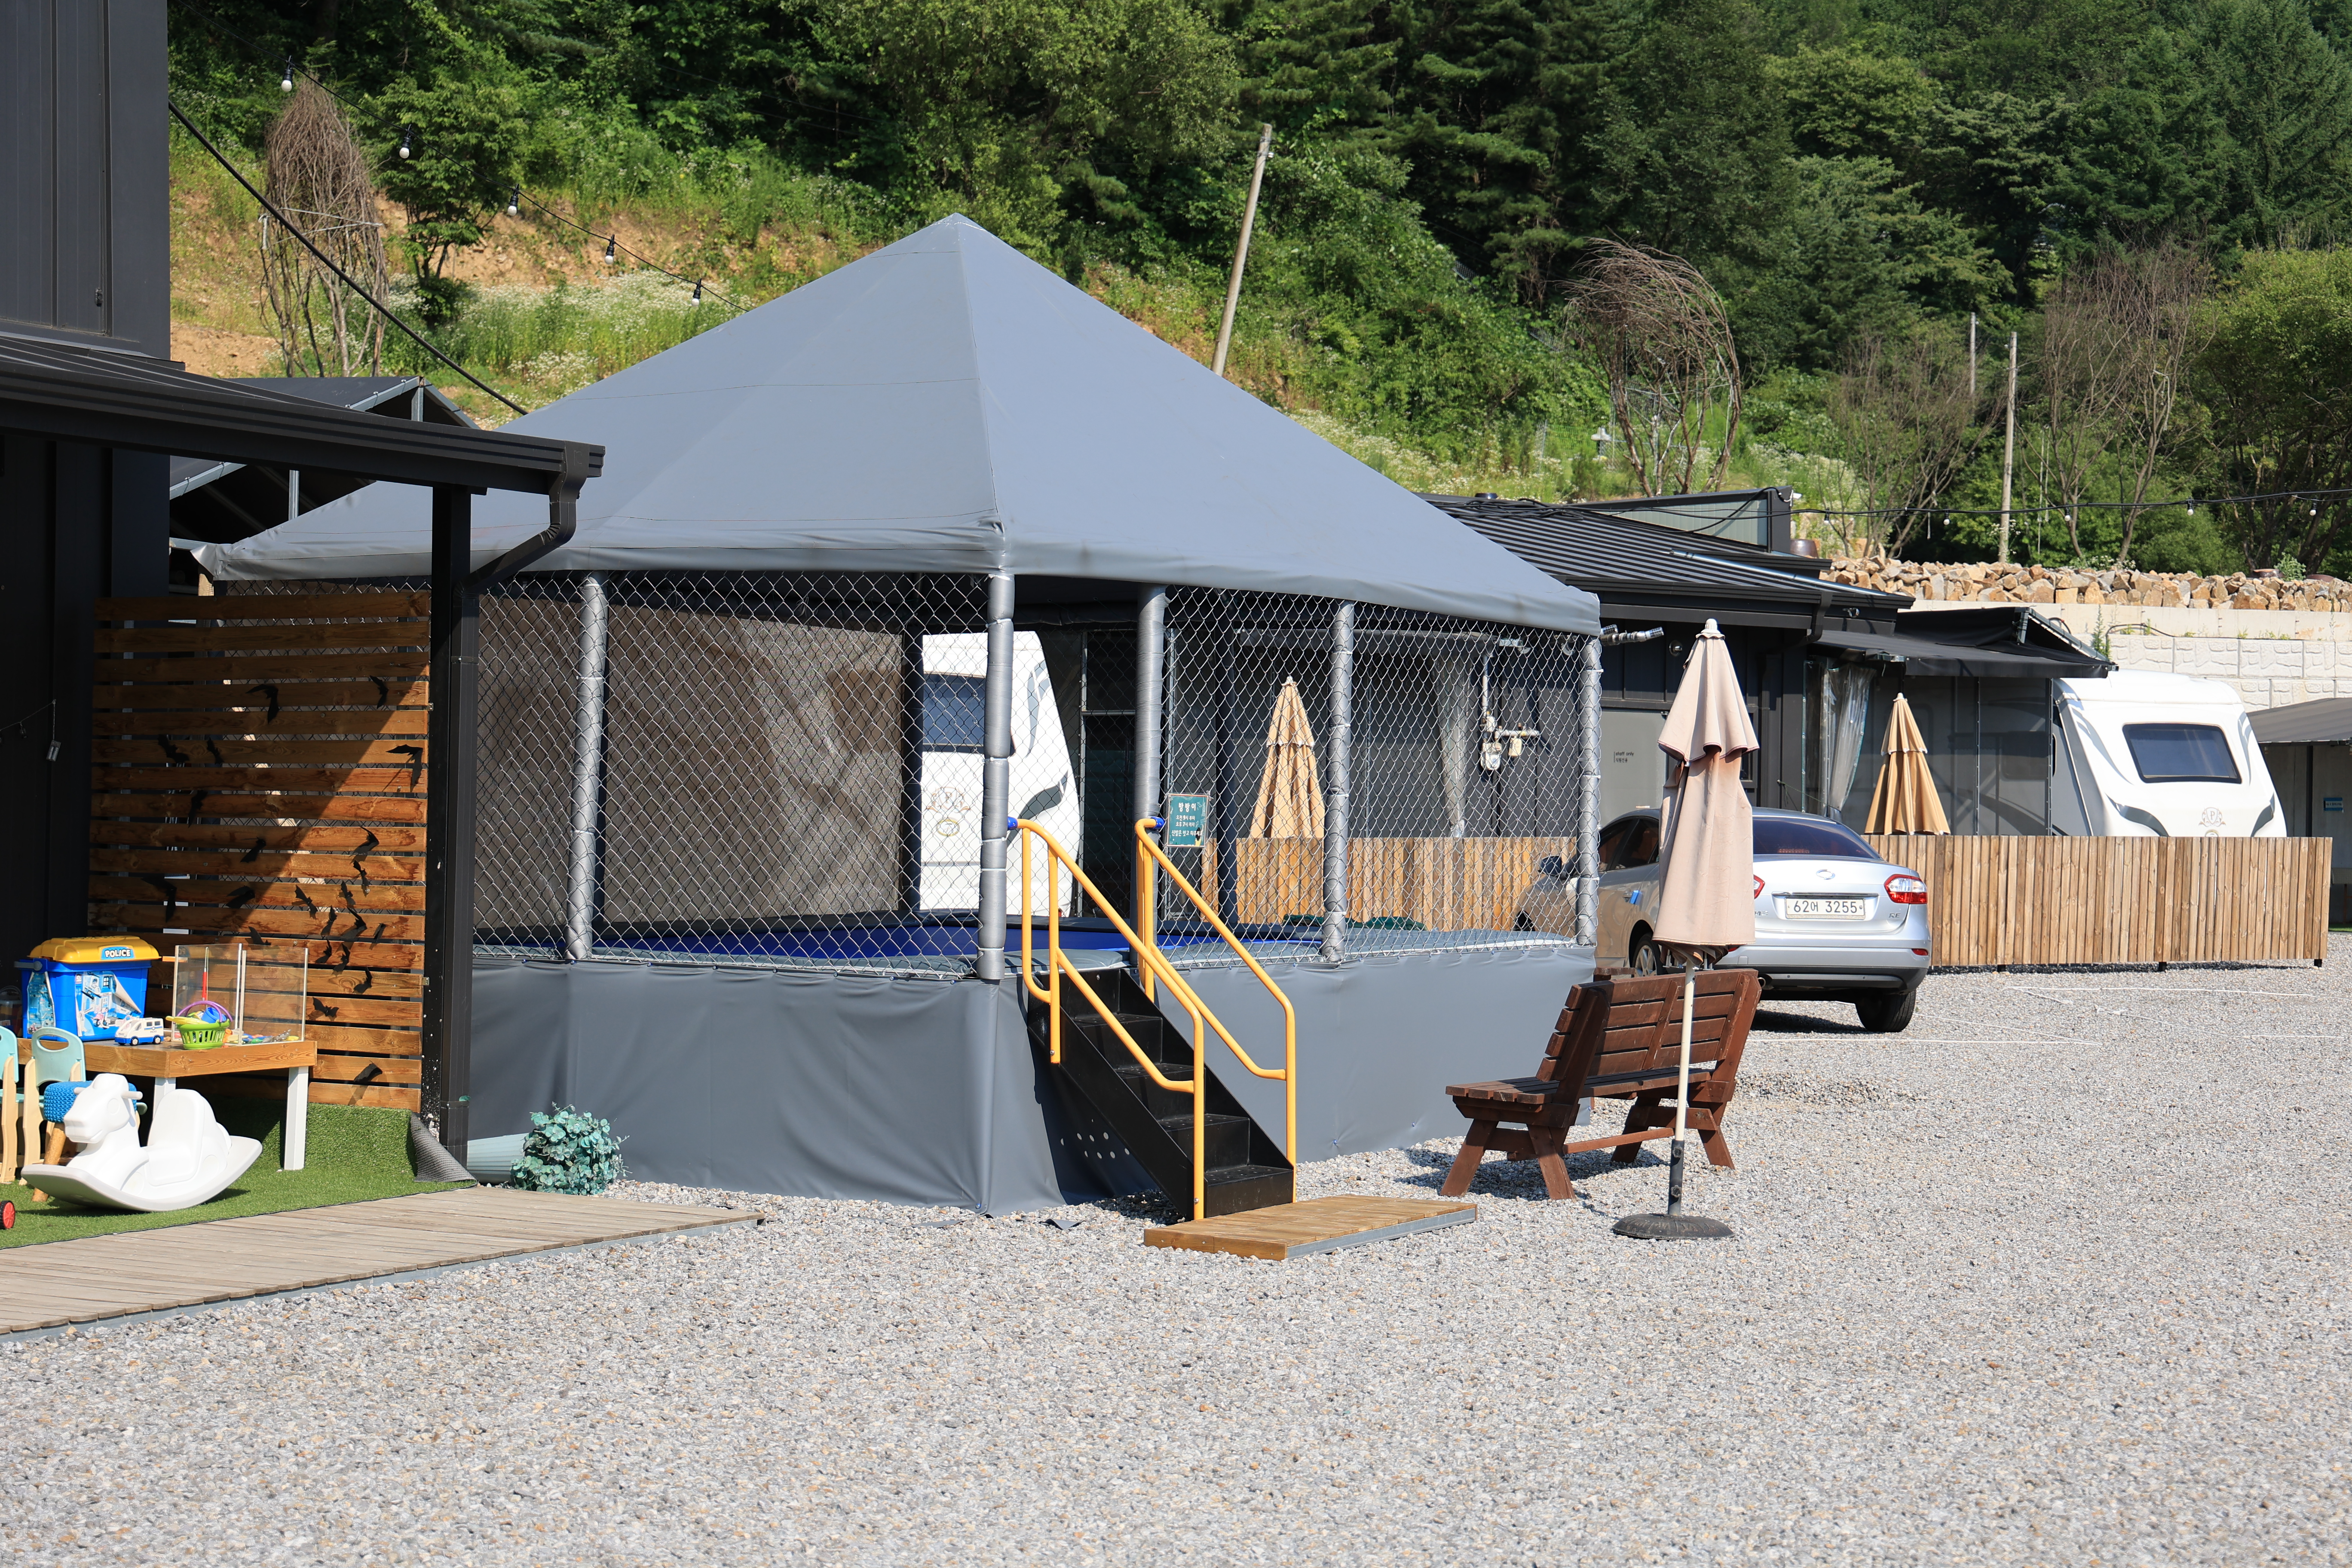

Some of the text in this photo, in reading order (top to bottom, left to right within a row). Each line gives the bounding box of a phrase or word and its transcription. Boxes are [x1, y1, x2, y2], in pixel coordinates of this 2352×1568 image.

[1179, 802, 1196, 812] 방방이
[1794, 900, 1857, 913] 62어 3255
[104, 949, 132, 958] POLICE
